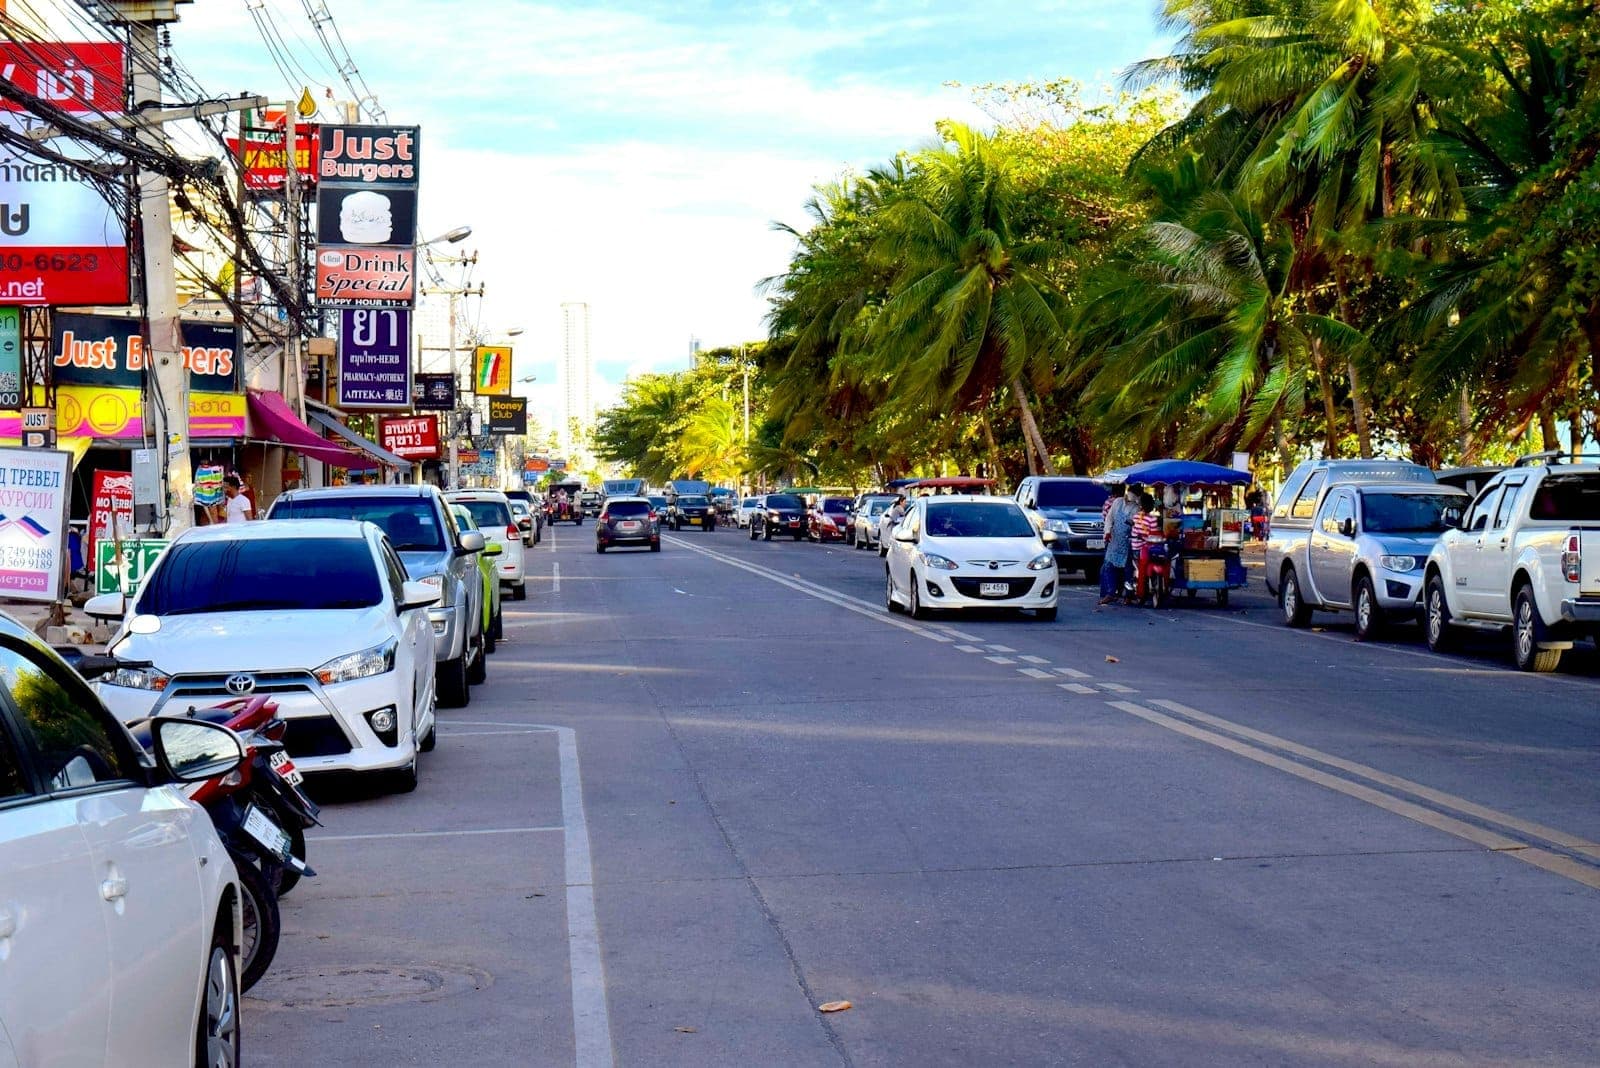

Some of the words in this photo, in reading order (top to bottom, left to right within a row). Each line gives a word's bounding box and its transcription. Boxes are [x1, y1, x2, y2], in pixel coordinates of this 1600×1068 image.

[323, 130, 413, 160] Just
[321, 159, 414, 182] Burgers
[345, 254, 408, 272] Drink
[0, 277, 44, 297] .net
[321, 274, 409, 295] Special
[353, 309, 397, 347] ยา
[54, 331, 117, 369] Just
[492, 401, 523, 411] Money
[492, 410, 513, 419] Club
[25, 413, 47, 426] JUST
[10, 468, 60, 488] ТРЕВЕЛ
[29, 558, 53, 569] 9189
